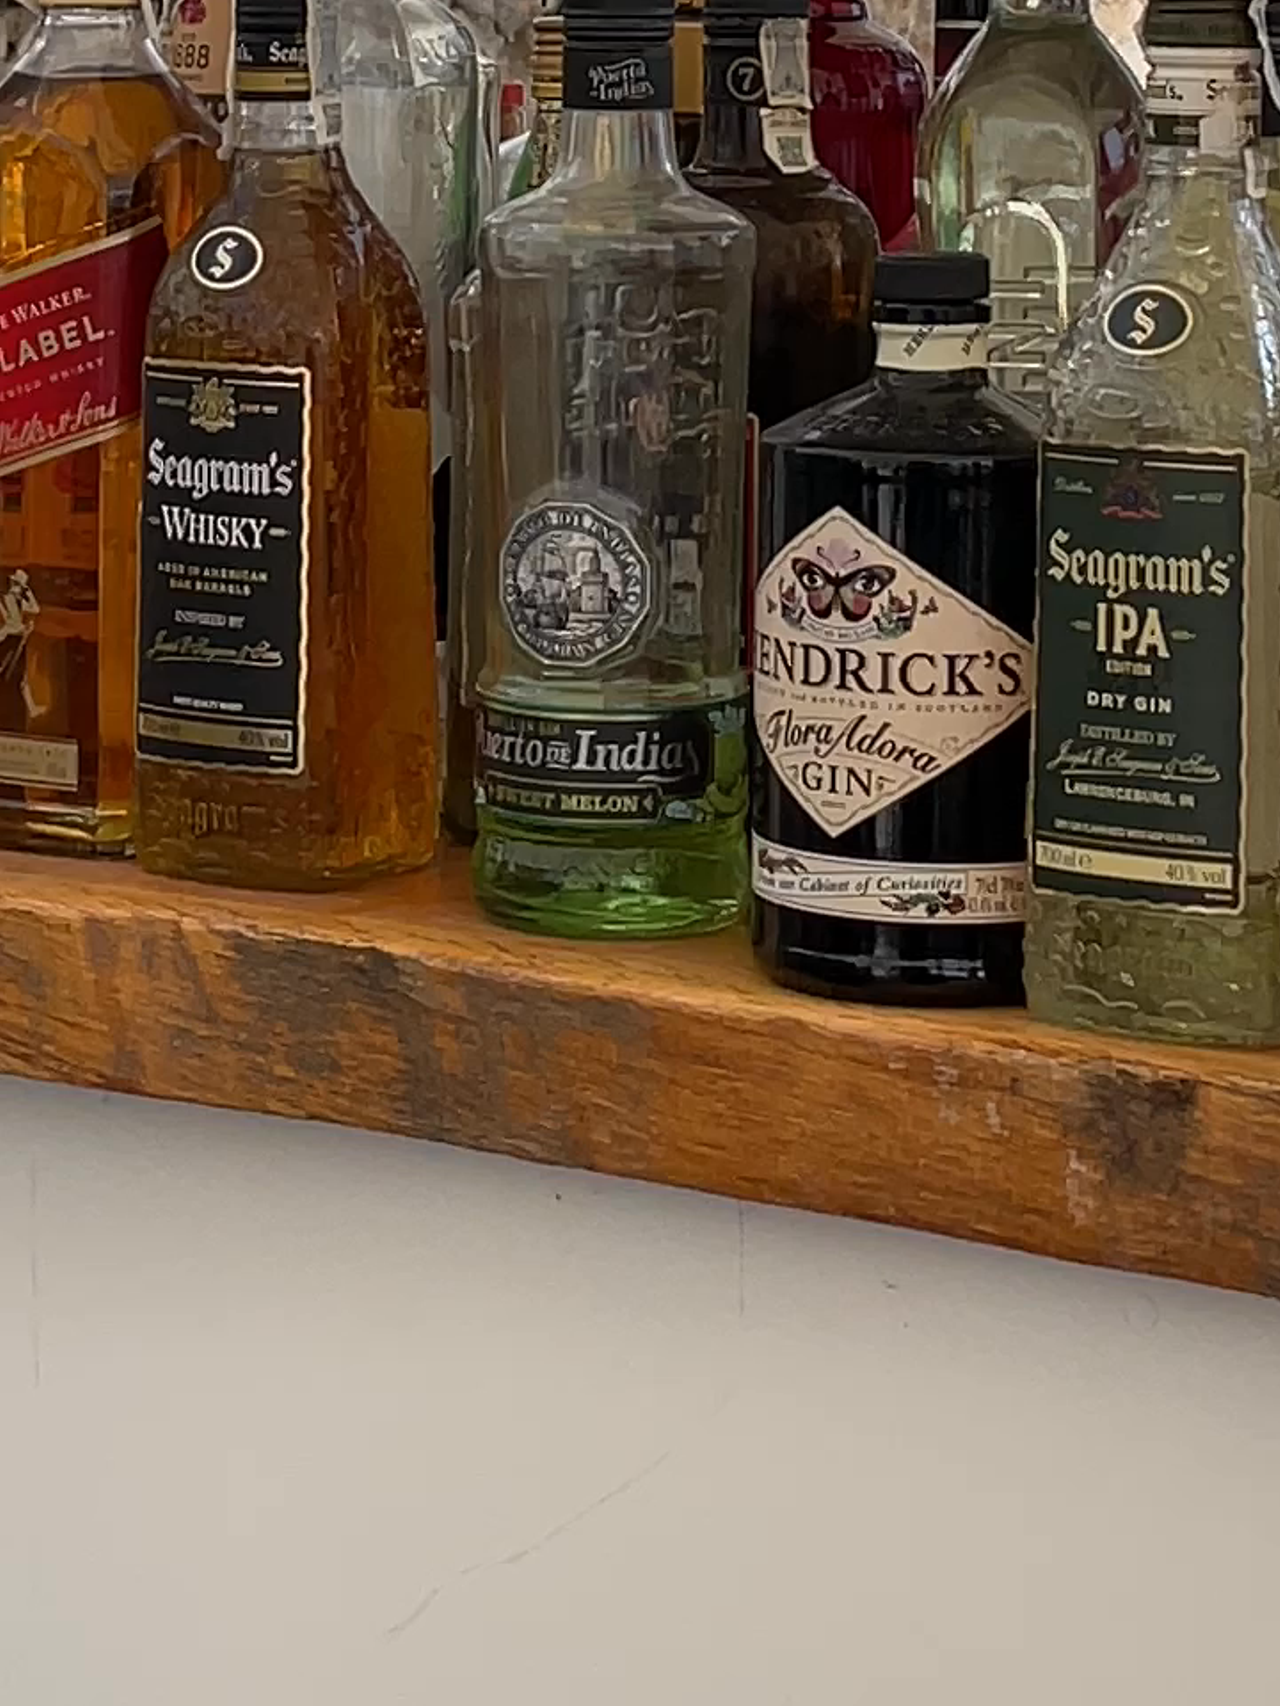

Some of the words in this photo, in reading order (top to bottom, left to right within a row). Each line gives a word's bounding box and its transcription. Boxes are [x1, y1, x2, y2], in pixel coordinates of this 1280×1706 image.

[146, 437, 295, 501] Seagram's
[160, 503, 269, 551] WHISKY
[1047, 527, 1232, 600] Seagram's
[1095, 601, 1171, 659] IPA
[756, 633, 1023, 699] ENDRICK'S
[1086, 689, 1128, 710] DRY
[1133, 695, 1172, 714] GIN
[560, 792, 640, 814] MELON
[800, 759, 872, 798] GIN
